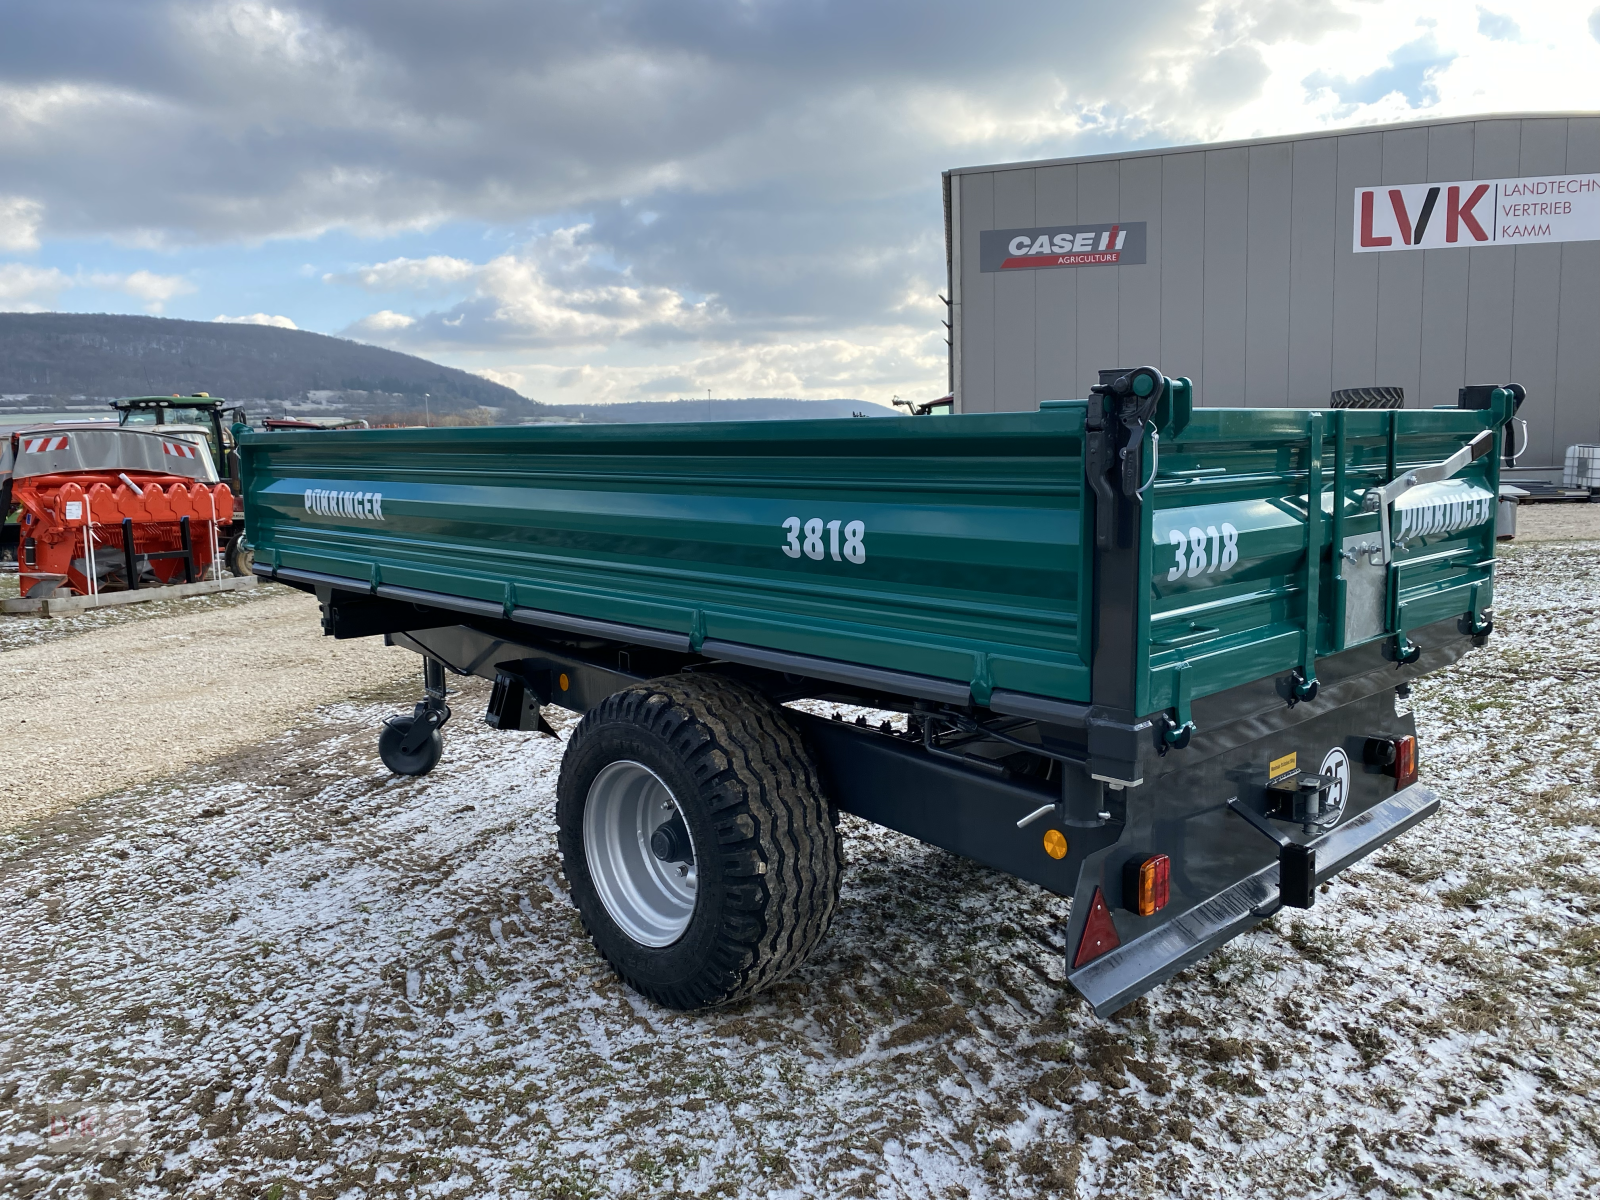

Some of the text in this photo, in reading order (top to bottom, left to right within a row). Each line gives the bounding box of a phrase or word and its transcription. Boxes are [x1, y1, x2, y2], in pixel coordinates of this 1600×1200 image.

[1360, 183, 1491, 248] LVK
[1502, 201, 1572, 217] VERTRIEB
[1502, 223, 1551, 238] KAMM
[1008, 232, 1096, 256] CASE
[1057, 253, 1117, 264] AGRICULTURE
[781, 516, 866, 565] 3818
[1167, 522, 1239, 582] 3818
